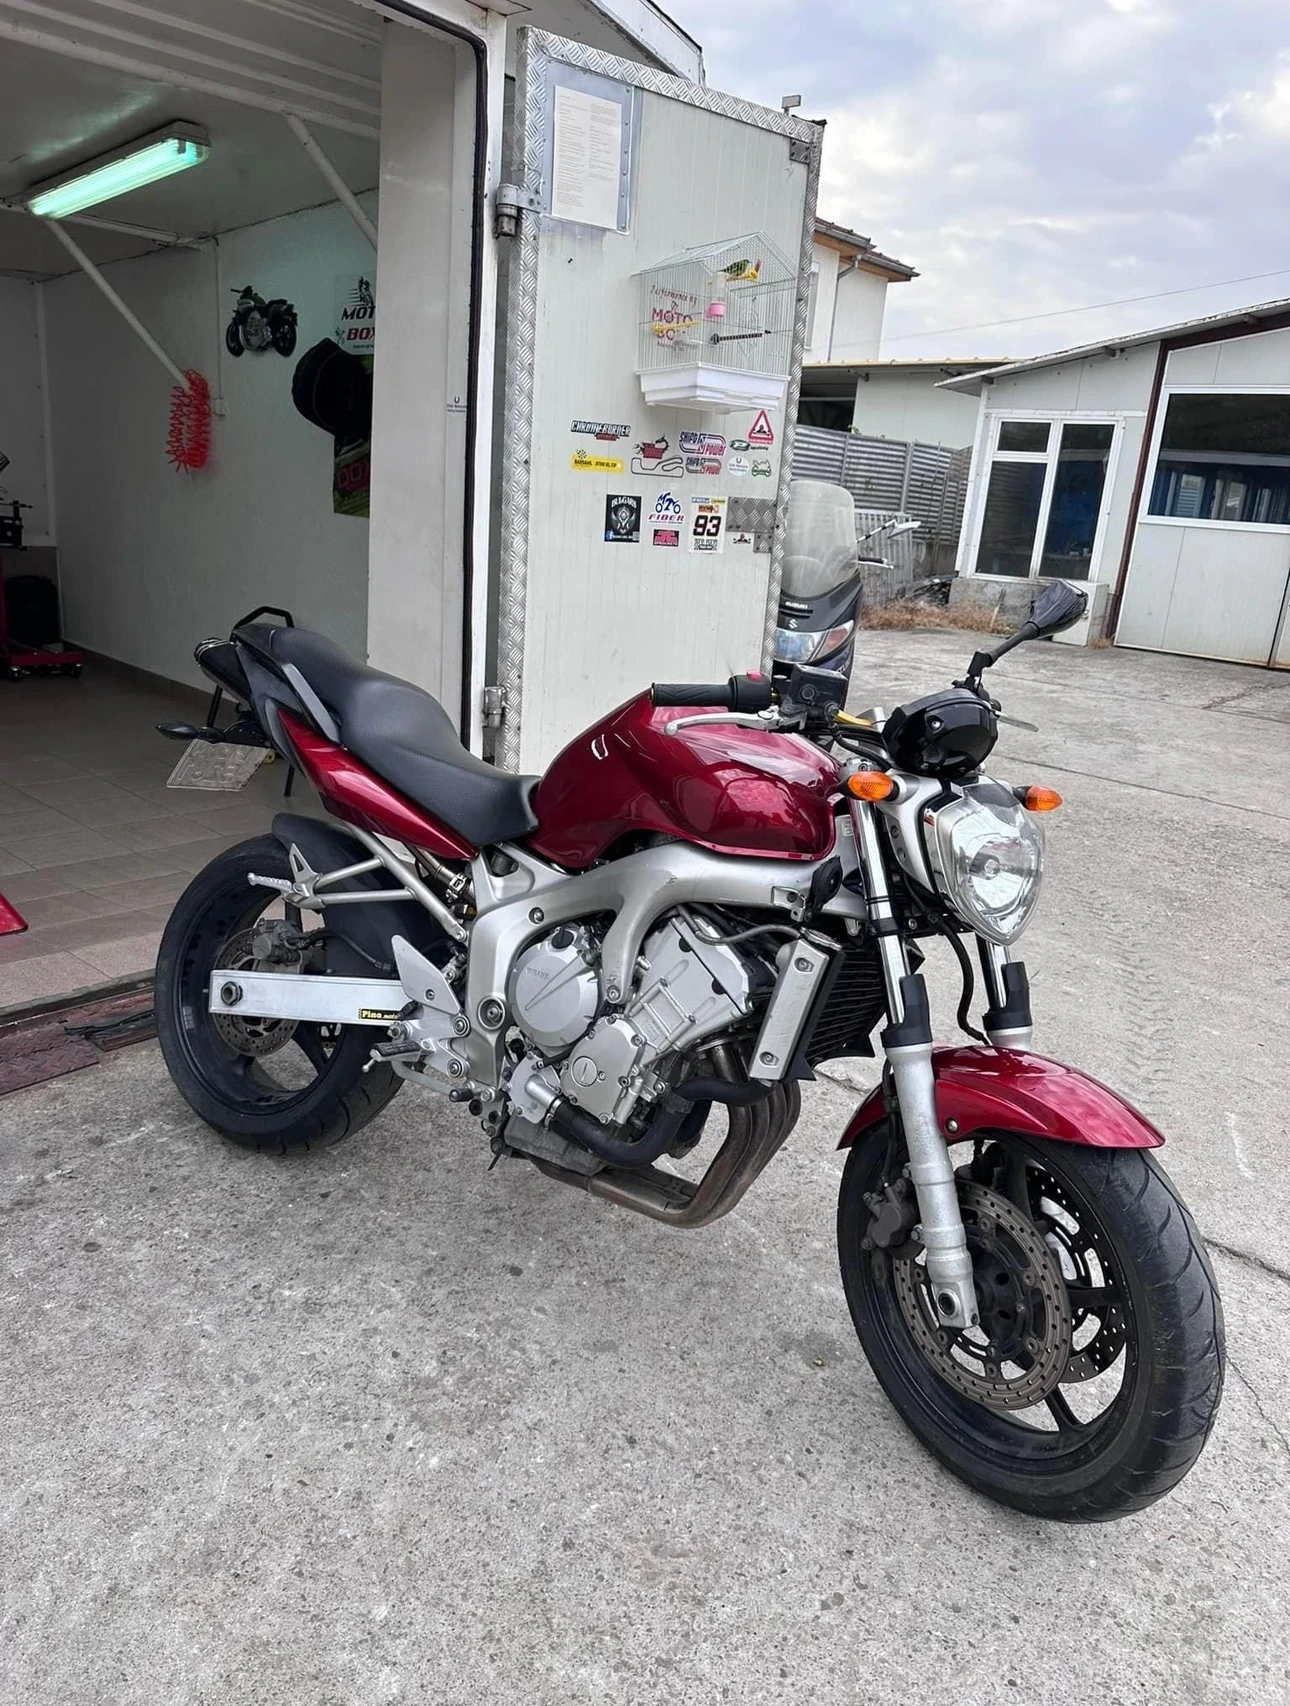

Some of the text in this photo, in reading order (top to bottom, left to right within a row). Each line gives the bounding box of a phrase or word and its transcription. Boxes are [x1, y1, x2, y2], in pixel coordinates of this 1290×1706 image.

[648, 513, 684, 522] FIBER
[693, 515, 721, 537] 93
[785, 601, 808, 609] SUZUKI
[361, 1010, 382, 1019] Pino
